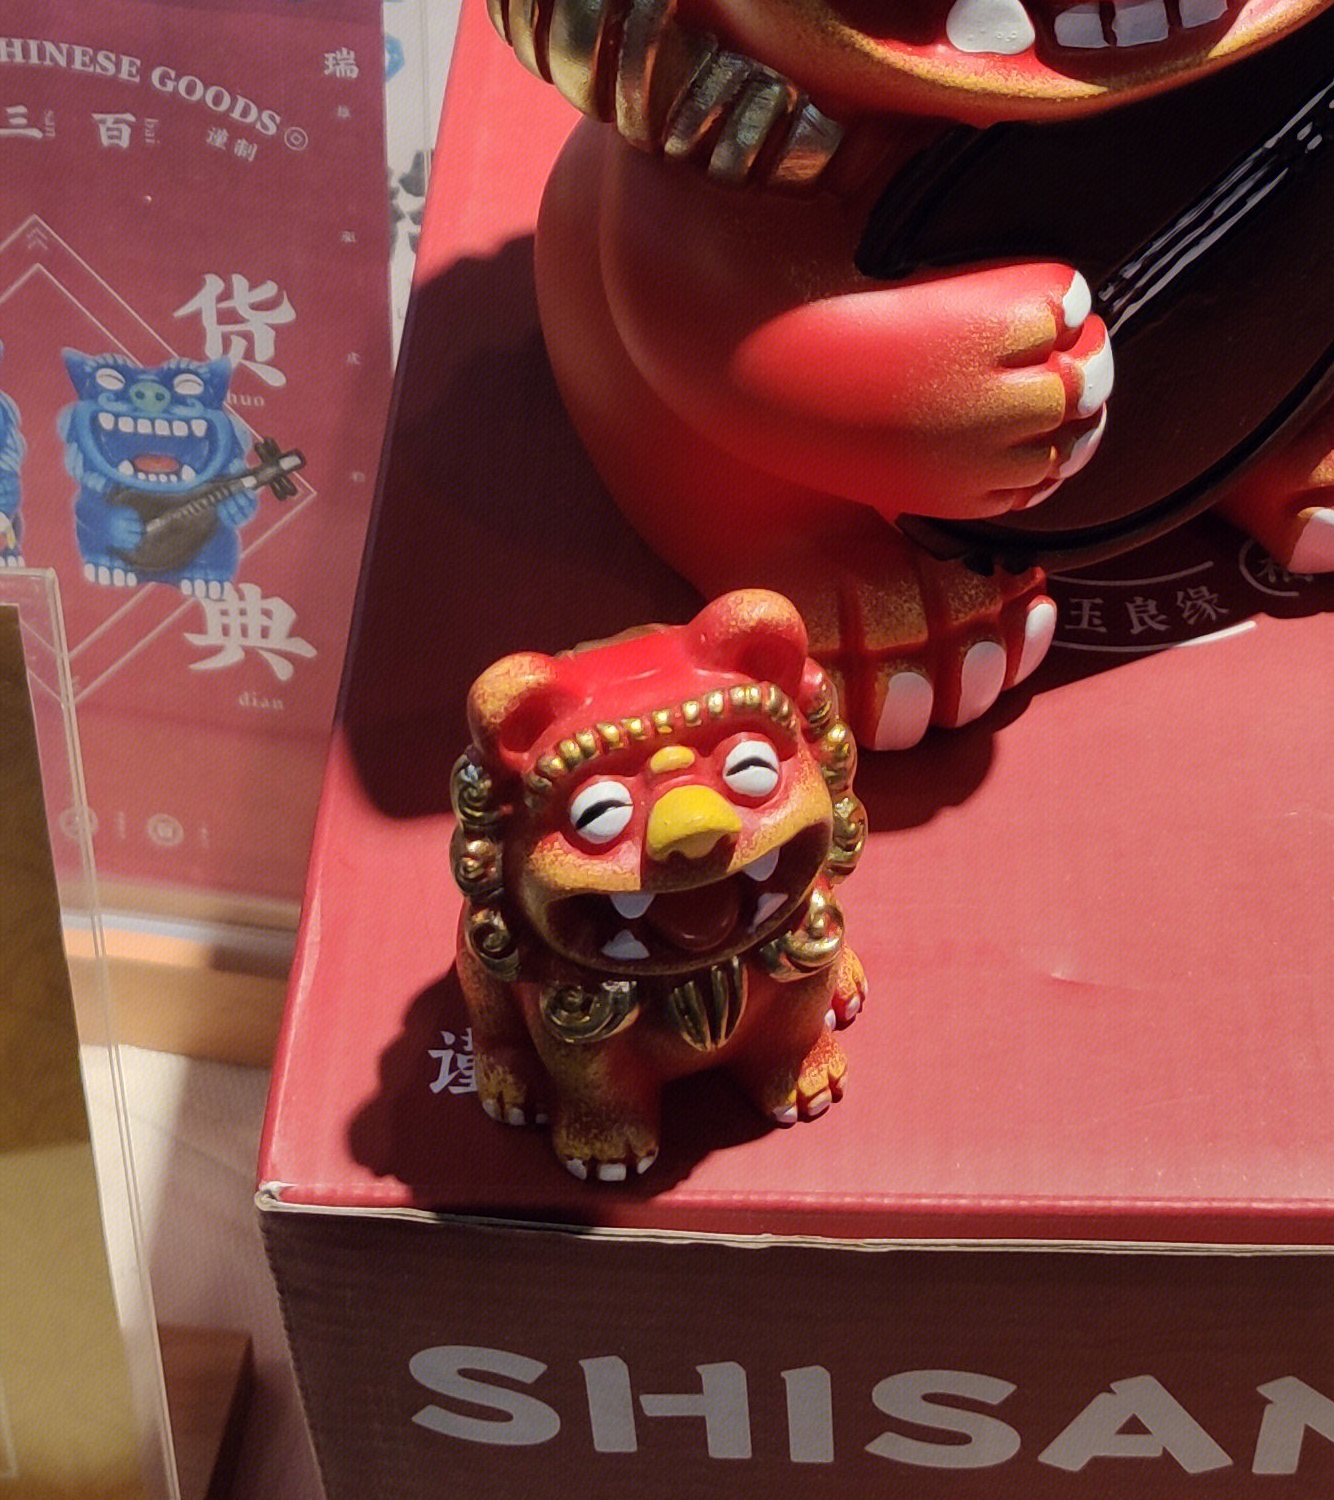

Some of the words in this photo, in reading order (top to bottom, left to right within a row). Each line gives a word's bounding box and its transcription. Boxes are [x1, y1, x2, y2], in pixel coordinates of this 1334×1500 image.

[324, 46, 359, 80] 瑞
[150, 65, 282, 137] GOODS
[183, 582, 318, 682] 典
